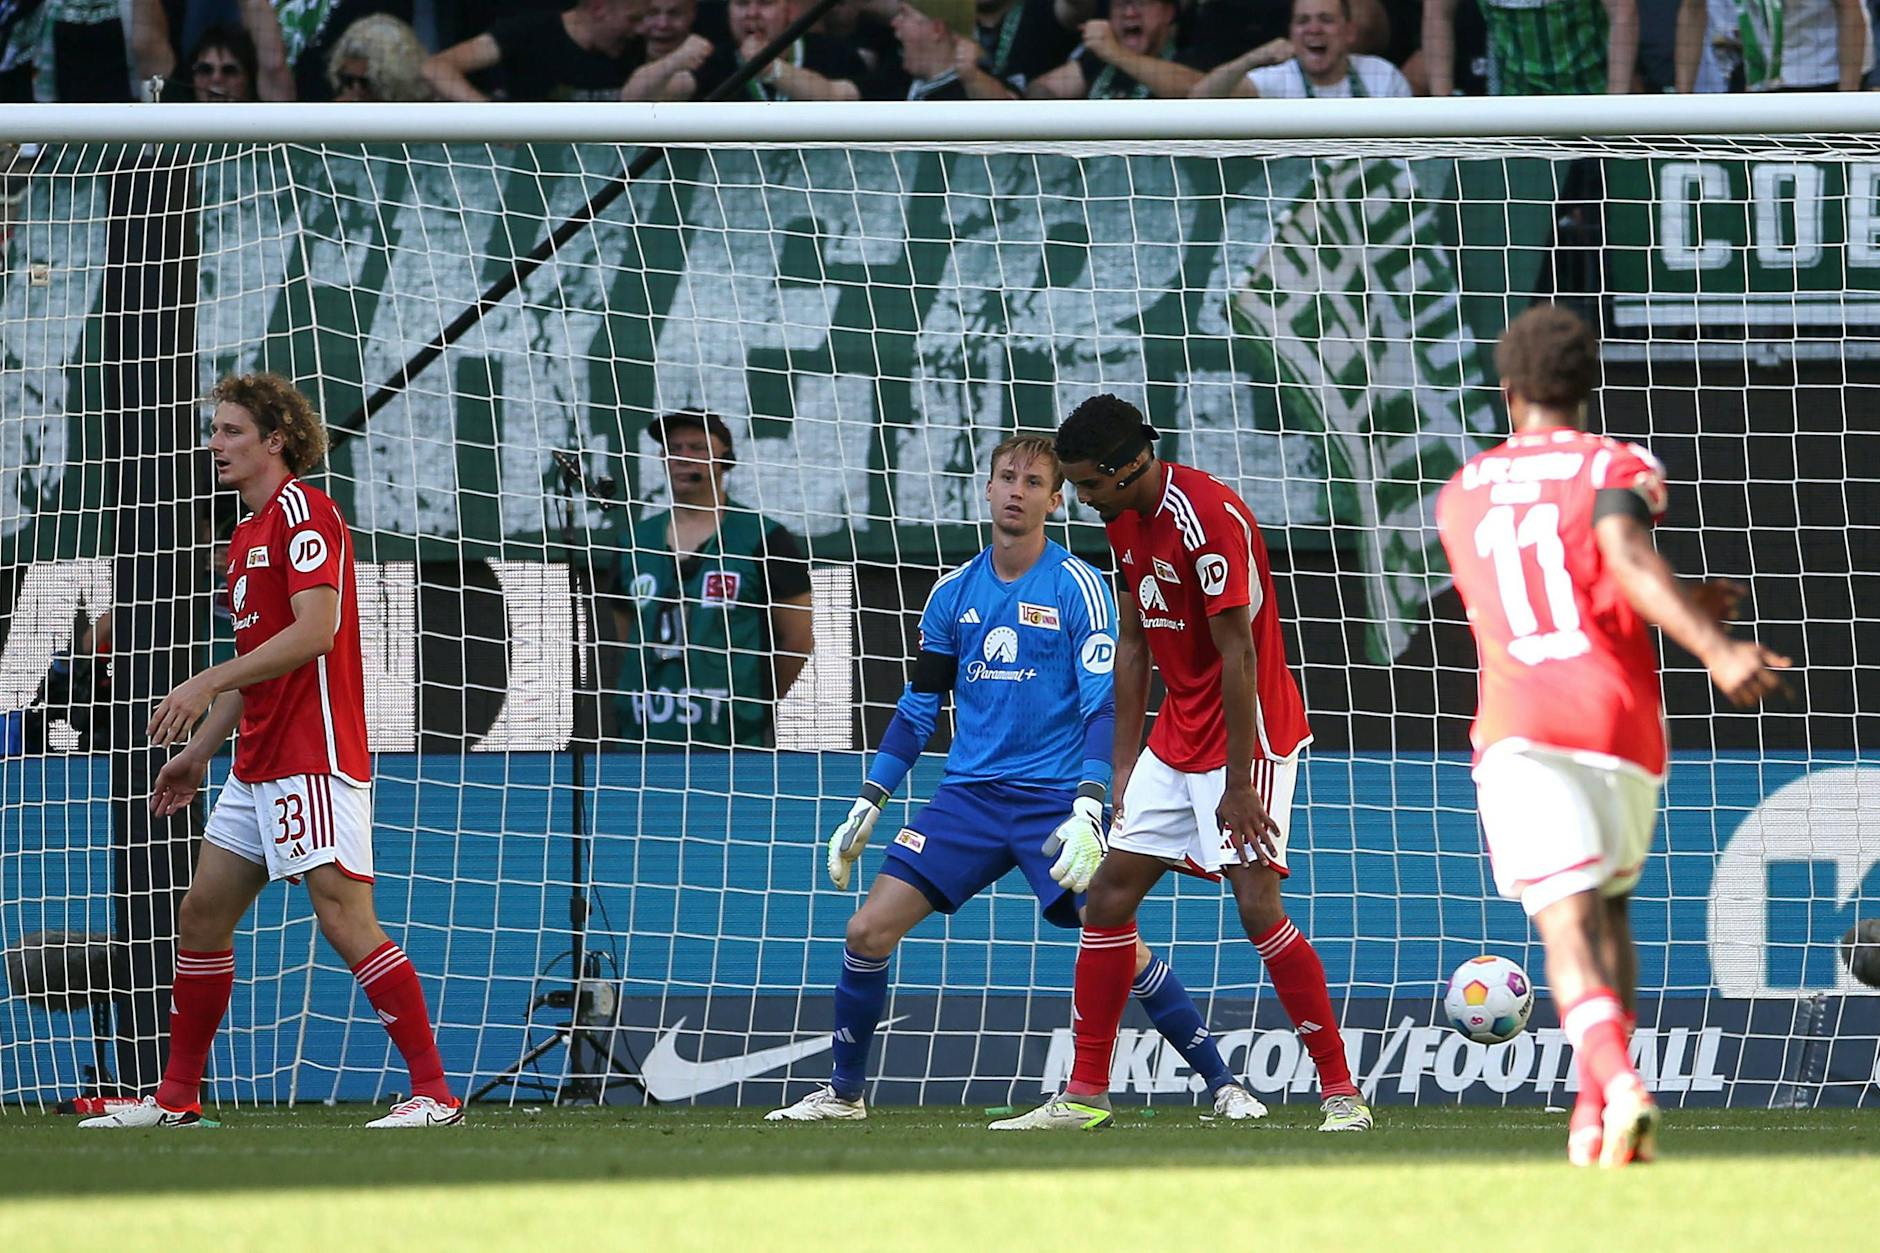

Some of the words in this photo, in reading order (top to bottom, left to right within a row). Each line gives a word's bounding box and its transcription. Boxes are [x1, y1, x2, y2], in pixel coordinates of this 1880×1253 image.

[296, 539, 321, 564] JD
[1203, 561, 1225, 589] JD
[1474, 503, 1580, 637] 11
[1086, 643, 1112, 664] JD
[631, 686, 729, 725] HOST
[275, 793, 306, 844] 33
